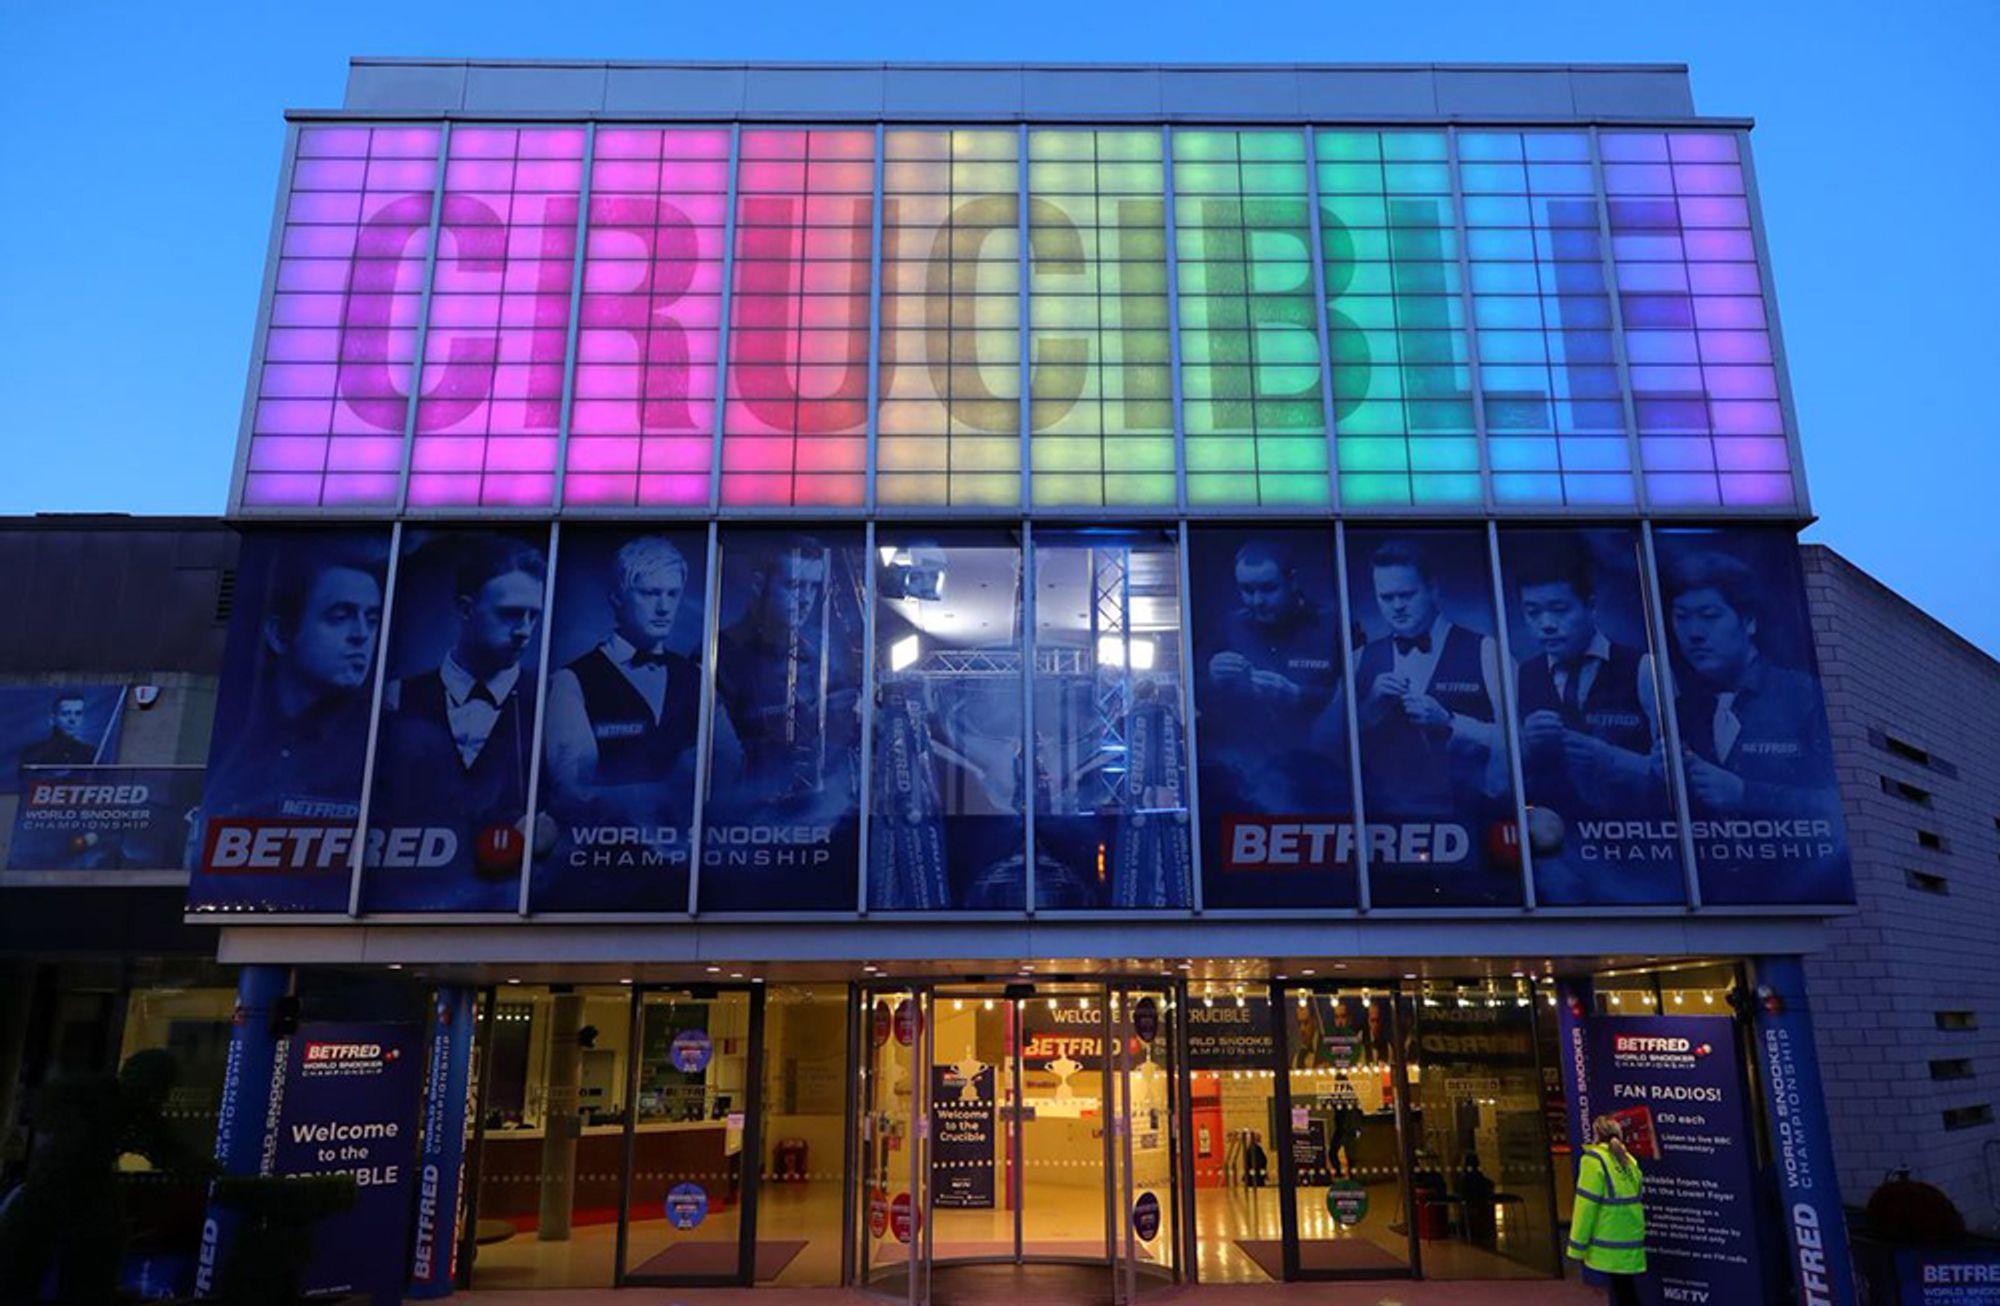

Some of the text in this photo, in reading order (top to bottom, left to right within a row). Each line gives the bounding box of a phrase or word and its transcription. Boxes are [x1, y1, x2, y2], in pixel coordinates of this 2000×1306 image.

[339, 193, 1714, 433] CRUCIBLE
[1436, 681, 1480, 692] BETFRED
[1742, 742, 1799, 754] BETFRED
[32, 785, 149, 804] BETFRED
[26, 809, 150, 820] WORLD SNOOKER
[23, 820, 149, 830] CHAMPIONSHIP
[1692, 819, 1831, 838] SNOOKER
[572, 826, 677, 845] WORLD
[210, 827, 458, 868] BETFRED
[1580, 843, 1835, 860] CHAMIONSHIP
[569, 849, 830, 867] CHAMPONSHIP
[308, 1044, 381, 1060] BETFRED
[1025, 1037, 1121, 1056] BETFRD
[1617, 1037, 1690, 1052] BETFRED
[303, 1060, 383, 1070] WORLD SNOOKER
[1572, 1027, 1588, 1092] SNOOKER
[1614, 1052, 1696, 1062] WORLD SNOOKER
[266, 1039, 287, 1130] SNOOKER
[1613, 1084, 1722, 1102] FAN RADIOS!
[425, 1035, 442, 1154] WORLD SNOOKER
[432, 1035, 450, 1155] CHAMPIONSHIP
[936, 1110, 990, 1120] Welcome
[1765, 1029, 1800, 1188] WORLD SNOOKER
[1778, 1028, 1813, 1190] CHAMPIONSHIP
[945, 1120, 980, 1132] to the
[1579, 1095, 1592, 1144] WORLD
[1657, 1113, 1706, 1125] £10 each
[291, 1121, 399, 1143] Welcome
[939, 1131, 987, 1143] Crucible
[317, 1144, 370, 1163] to the
[413, 1164, 439, 1280] BETFRED
[1923, 1264, 2000, 1283] BETFRE
